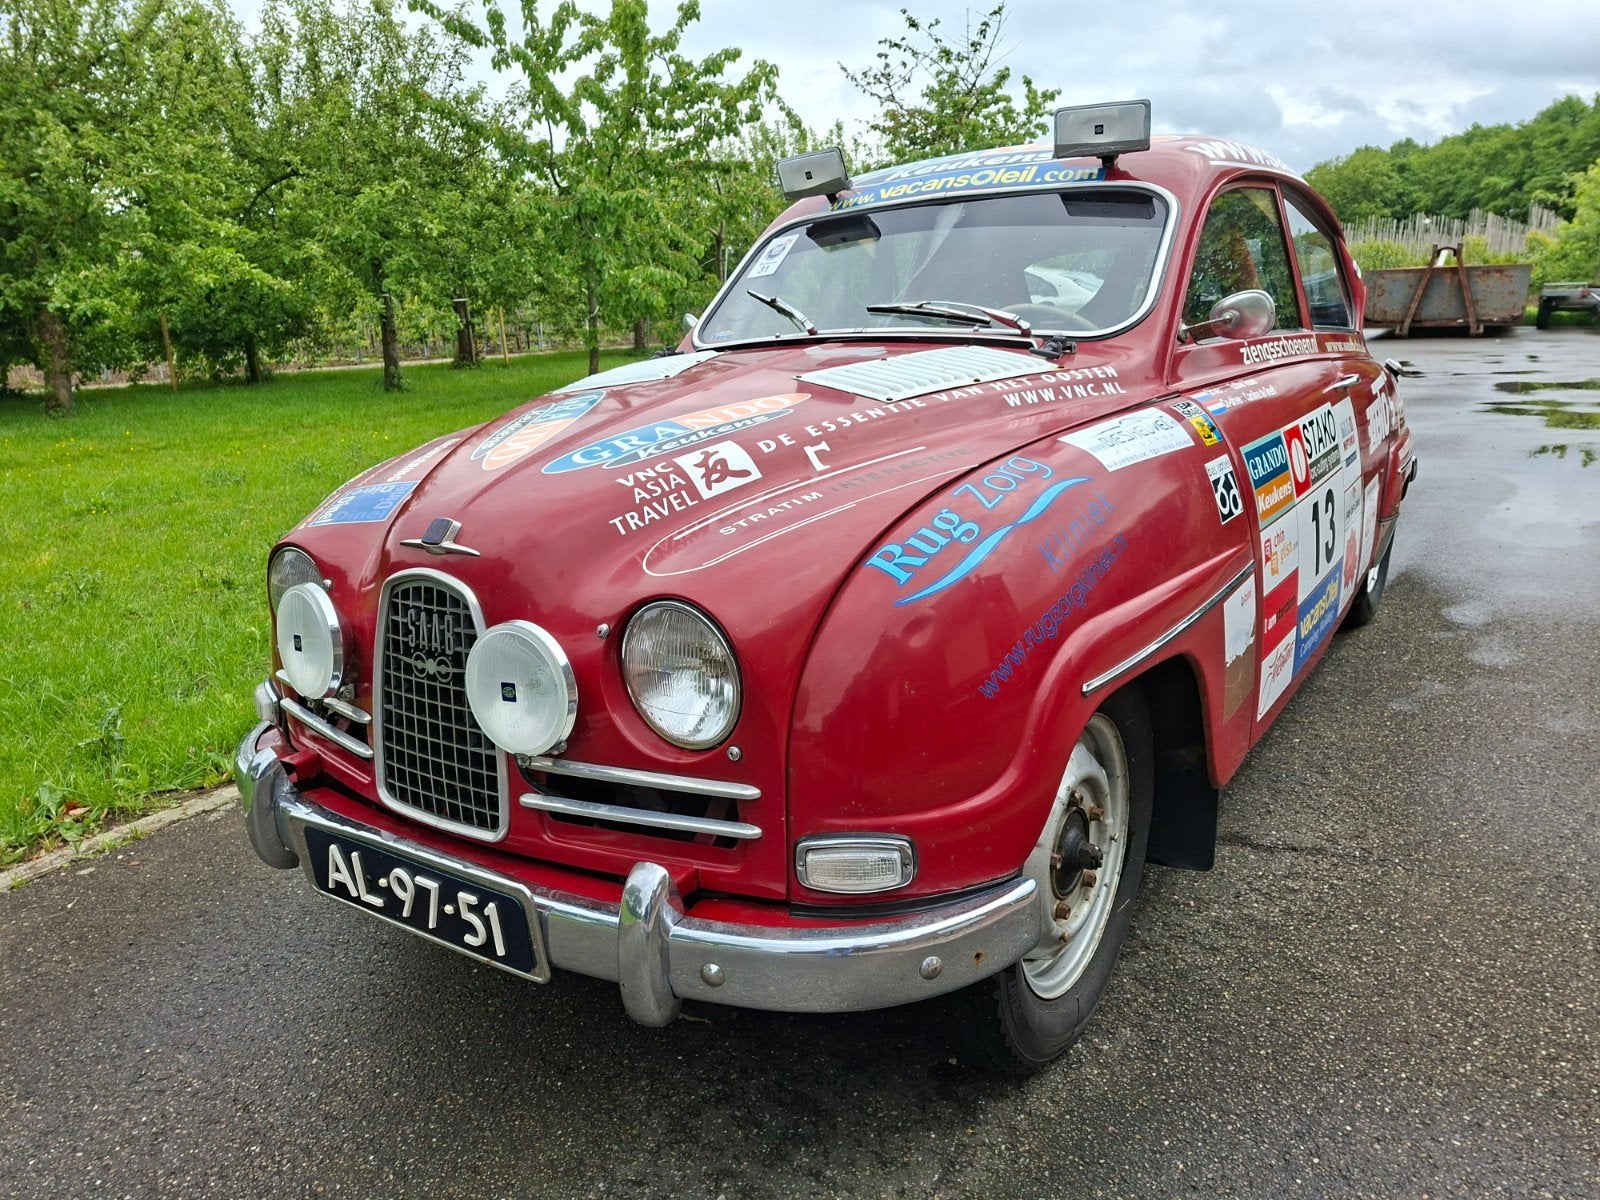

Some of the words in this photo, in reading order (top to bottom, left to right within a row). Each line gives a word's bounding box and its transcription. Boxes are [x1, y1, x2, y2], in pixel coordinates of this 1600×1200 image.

[756, 432, 796, 454] DE
[804, 396, 927, 437] ESSENTIE
[939, 384, 983, 402] VAN
[989, 376, 1033, 395] HET
[1040, 365, 1119, 384] OOSTEN
[1002, 381, 1127, 408] WWW.VNC.NL
[571, 397, 791, 464] GRANDO
[639, 415, 770, 459] Keukens
[1302, 409, 1337, 460] STAKO
[615, 462, 674, 487] VNC
[1249, 444, 1286, 480] GRANDO
[608, 490, 699, 535] TRAVEL
[634, 474, 686, 504] ASIA
[718, 491, 825, 536] STRATIM
[829, 447, 974, 493] INTERACTIVE
[1257, 480, 1292, 514] Keukens
[864, 508, 981, 586] Rug
[952, 456, 1055, 510] Zorg
[1037, 489, 1117, 573] Kliniek
[1311, 488, 1336, 577] 13
[407, 608, 454, 655] SAAB
